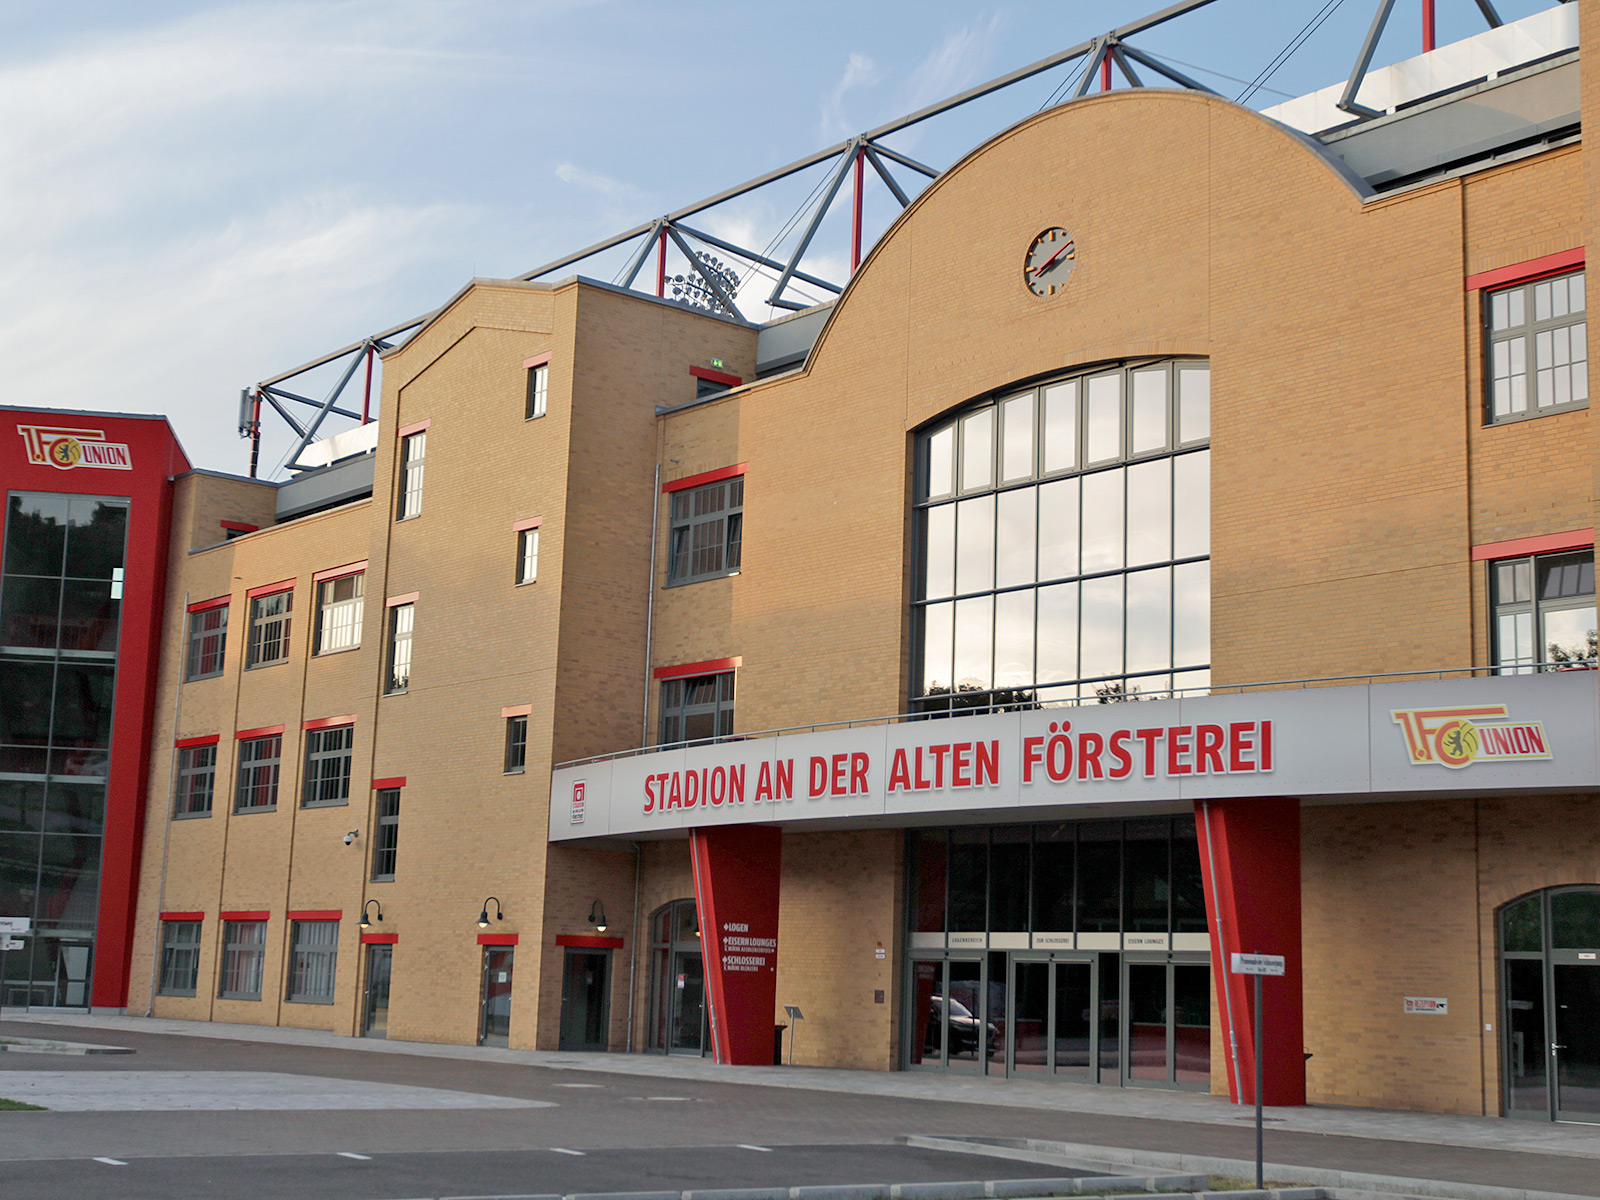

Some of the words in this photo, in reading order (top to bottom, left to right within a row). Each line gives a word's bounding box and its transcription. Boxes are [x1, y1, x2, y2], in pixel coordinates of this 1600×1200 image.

[82, 445, 127, 466] UNION
[1479, 727, 1545, 755] UNION
[644, 764, 746, 812] STADION
[755, 758, 794, 801] AN
[809, 752, 870, 797] DER
[888, 740, 999, 792] ALTEN
[1023, 721, 1272, 783] FÖRSTEREI
[729, 923, 748, 932] LOGEN
[728, 937, 749, 946] EISERN
[750, 938, 776, 947] LOUNGES
[728, 956, 765, 966] SCHLOSSEREI
